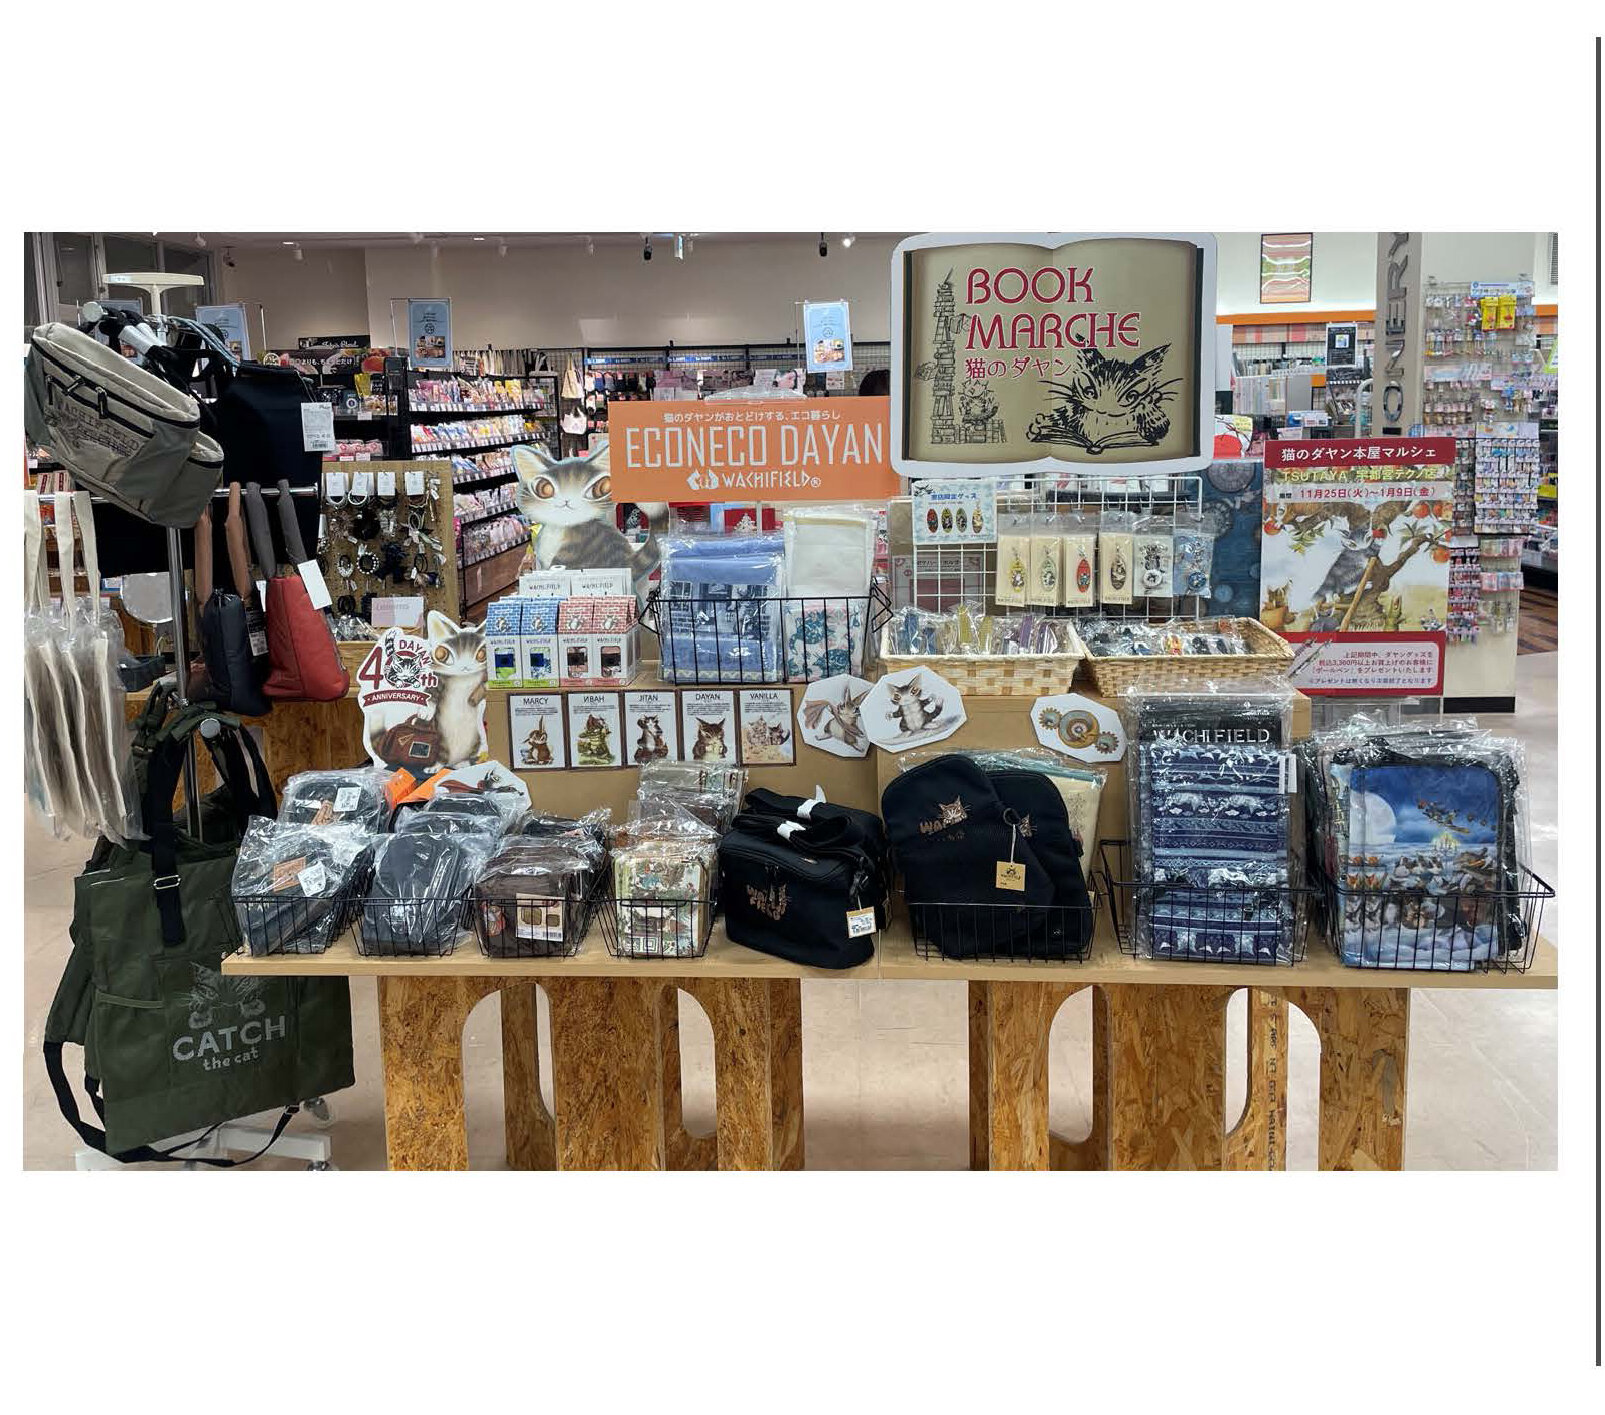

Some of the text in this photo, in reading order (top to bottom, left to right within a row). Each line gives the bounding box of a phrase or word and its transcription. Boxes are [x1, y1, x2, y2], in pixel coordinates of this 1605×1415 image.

[965, 266, 1094, 305] BOOK
[965, 312, 1141, 350] MARCHE
[965, 356, 1072, 379] 猫のダヤン
[663, 410, 842, 423] 猫のダヤンがおとどけする、エコ暮らし
[625, 423, 883, 468] ECONECO DAYAN
[1281, 445, 1437, 462] 猫のダヤン本屋マルシェ
[1283, 468, 1438, 482] TSUTAYA 宇都宮テクノ店
[399, 639, 432, 666] DAYAN
[371, 692, 422, 702] ANNIVERSARY
[522, 697, 549, 706] MARCY
[695, 693, 722, 702] DAYAN
[749, 692, 779, 701] VANILLA
[172, 1015, 286, 1061] CATCH
[202, 1046, 259, 1071] the cat
